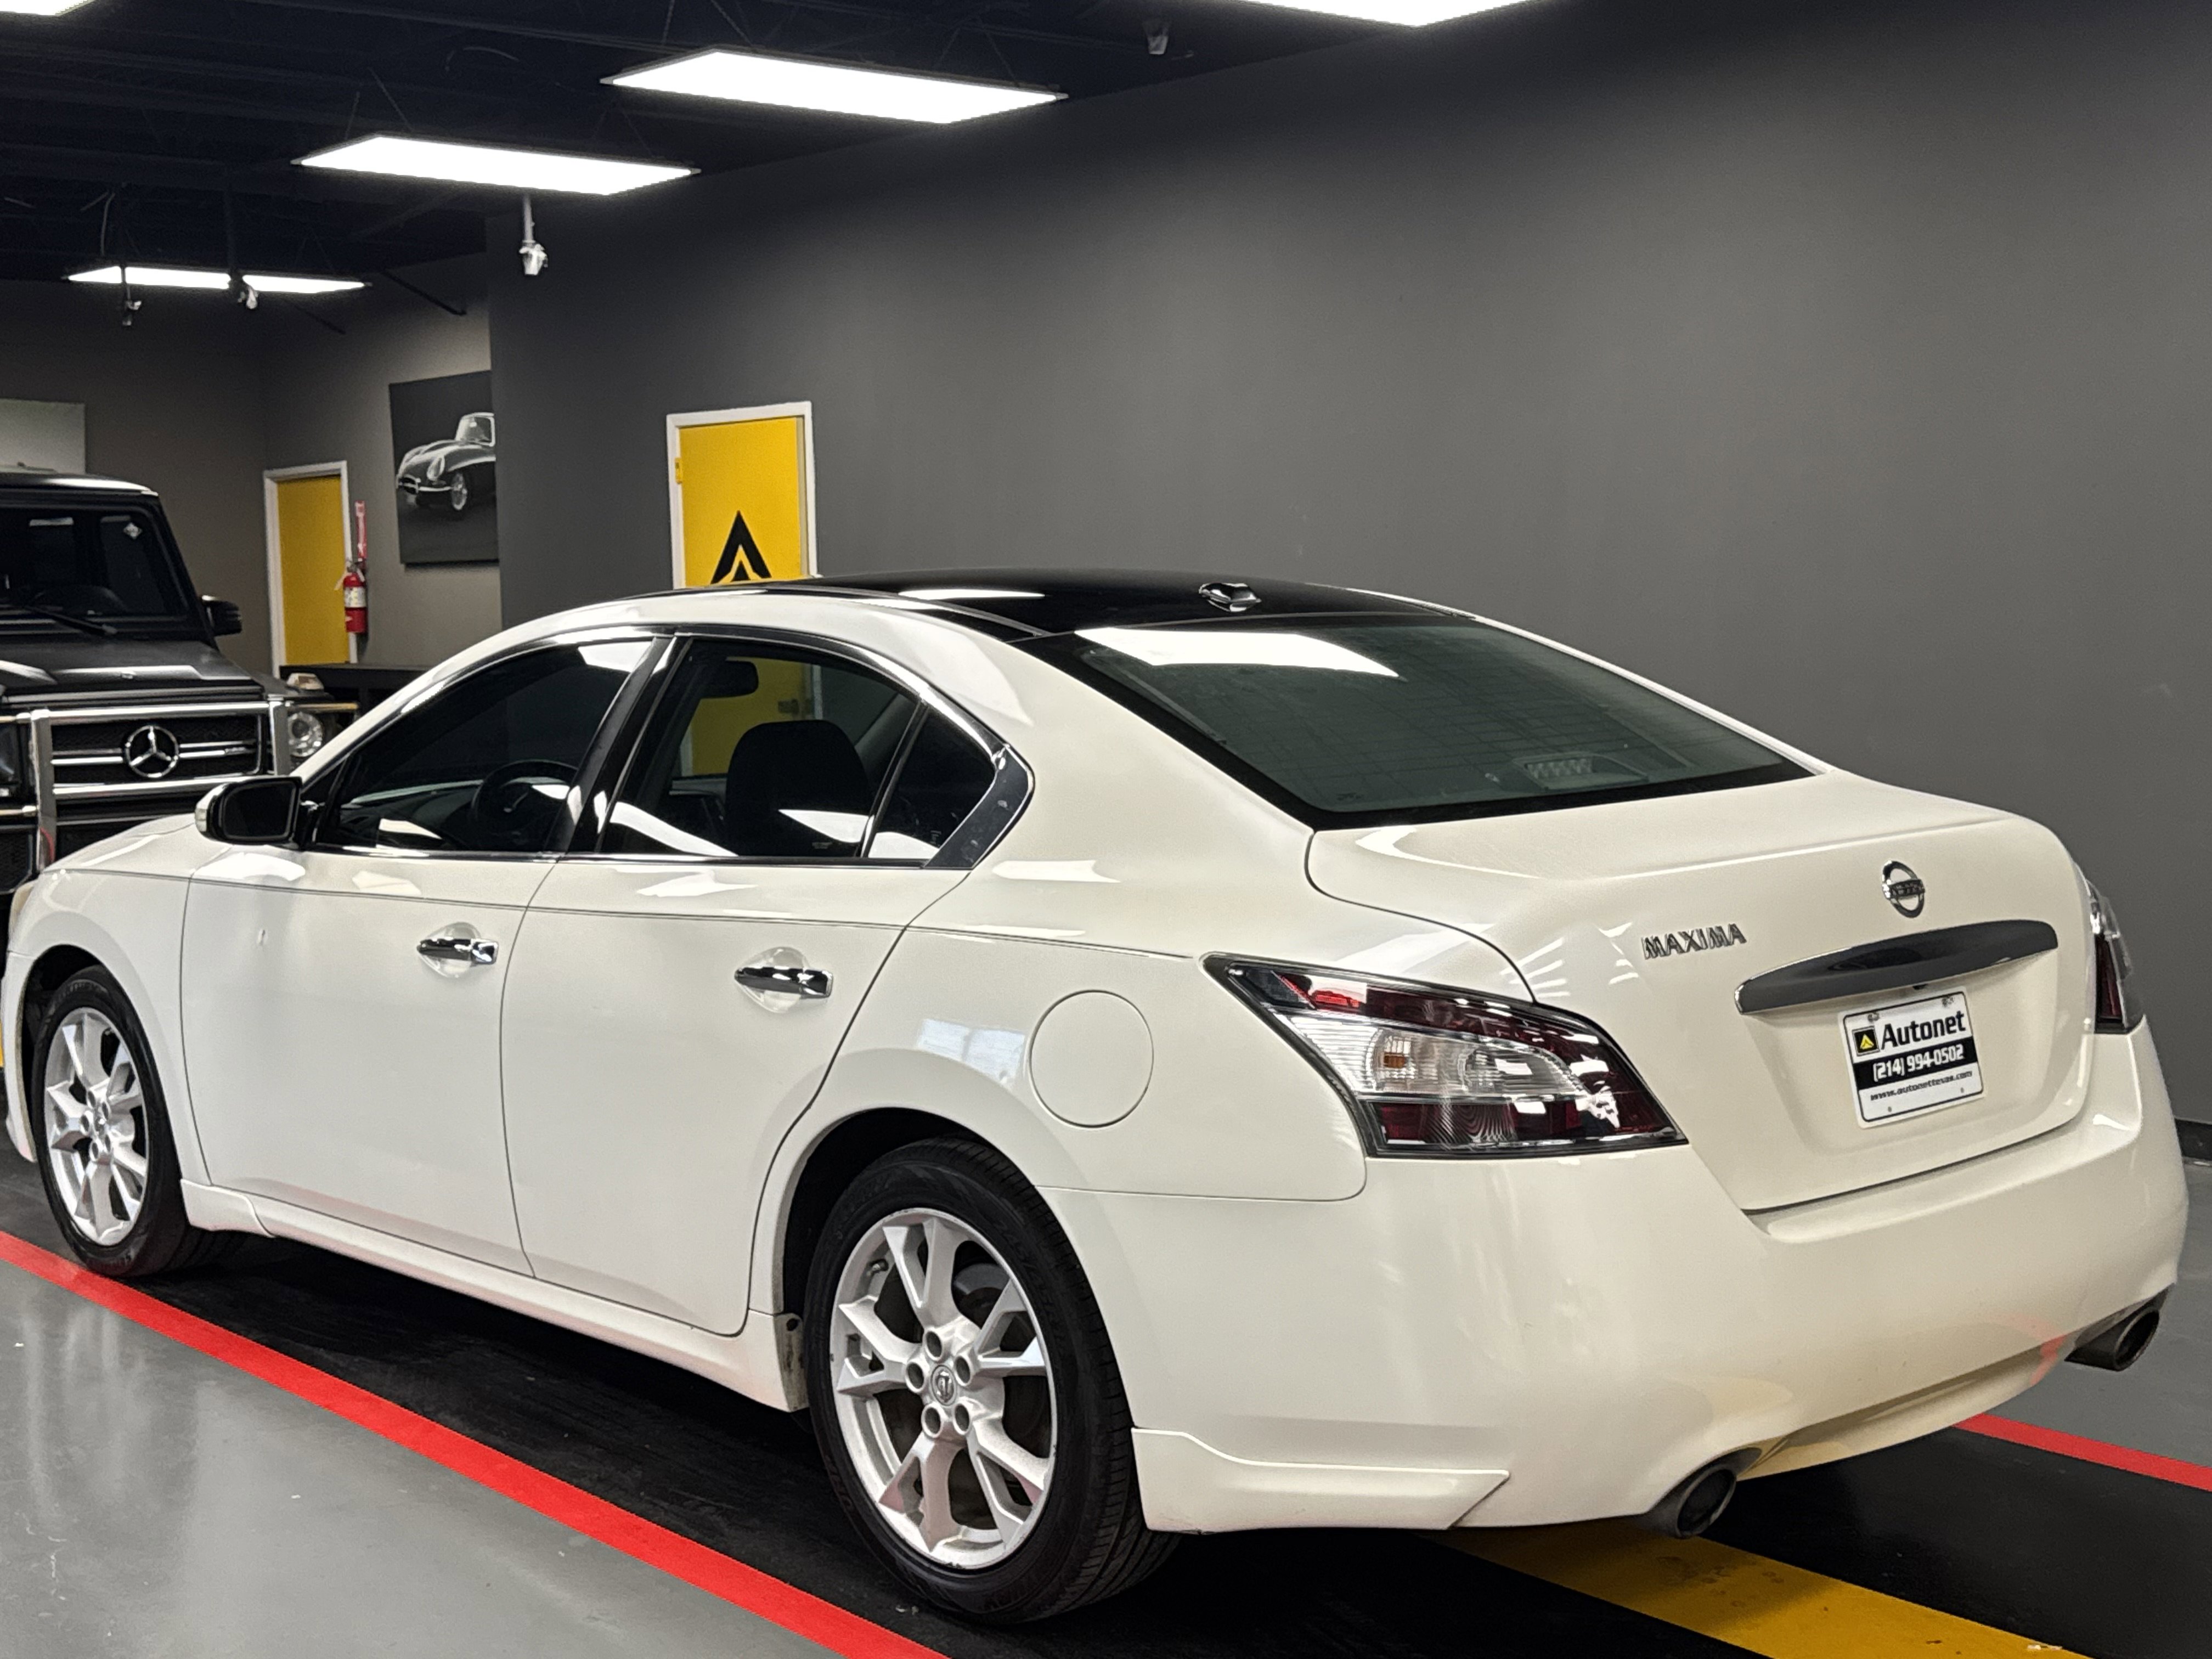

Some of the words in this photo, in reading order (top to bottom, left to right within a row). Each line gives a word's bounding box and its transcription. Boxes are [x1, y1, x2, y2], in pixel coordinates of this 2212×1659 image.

[1641, 923, 1747, 960] MAXIMA
[1881, 1010, 1966, 1050] Autonet
[1872, 1057, 1905, 1082] (214)
[1906, 1043, 1965, 1071] 994-0502
